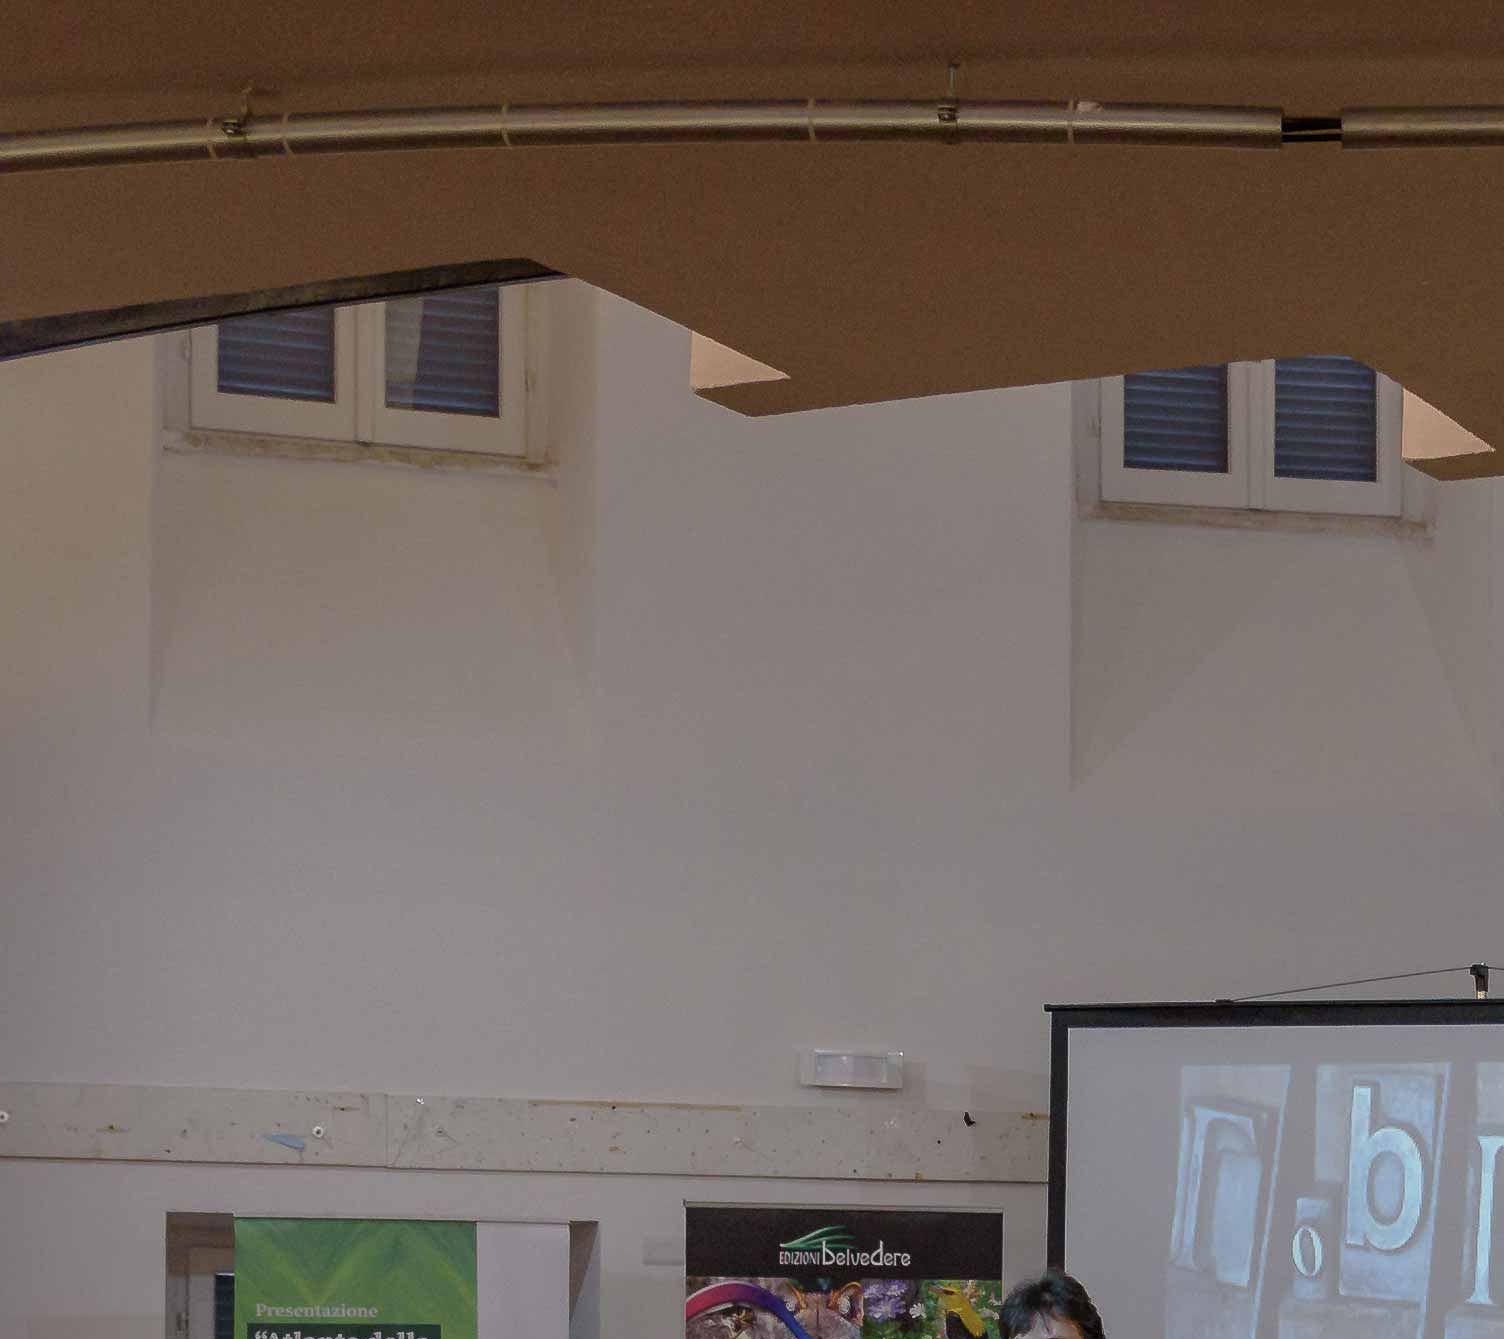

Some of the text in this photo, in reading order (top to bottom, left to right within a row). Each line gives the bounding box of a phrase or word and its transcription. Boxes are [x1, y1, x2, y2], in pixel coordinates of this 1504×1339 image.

[779, 1241, 912, 1267] EDIZIONI belvedere
[256, 1303, 379, 1319] Presentazione
